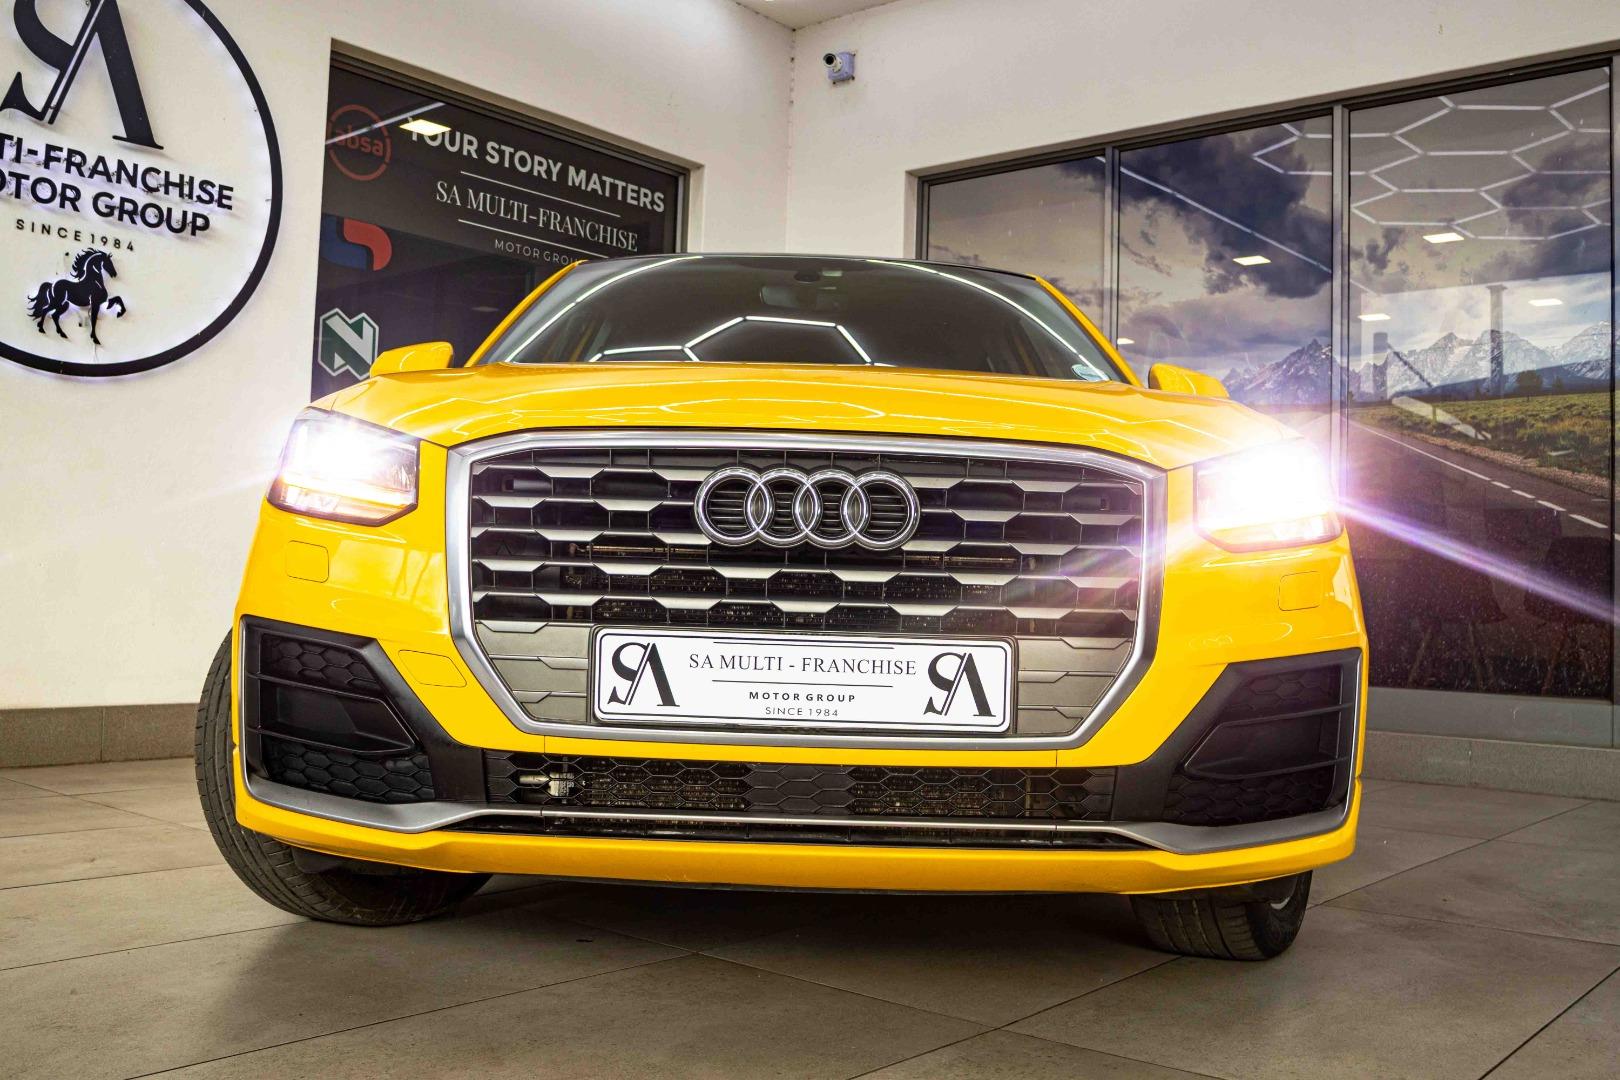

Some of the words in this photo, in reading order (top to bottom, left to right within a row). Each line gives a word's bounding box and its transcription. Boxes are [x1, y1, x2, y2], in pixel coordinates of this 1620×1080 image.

[485, 141, 562, 182] STORY
[567, 165, 665, 212] MATTERS
[0, 168, 80, 212] TOR
[92, 191, 210, 236] GROUP
[436, 180, 462, 206] SA
[467, 189, 638, 252] MULTI-FRANCHISE
[16, 218, 82, 241] SINCE
[90, 233, 135, 251] 1984
[494, 240, 540, 259] MOTOR
[690, 654, 714, 669] SA
[720, 655, 783, 671] MULTI
[802, 657, 917, 676] FRANCHISE
[749, 691, 800, 701] MOTOR
[806, 693, 855, 703] GROUP
[765, 706, 803, 716] SINCE
[808, 708, 838, 717] 1984
